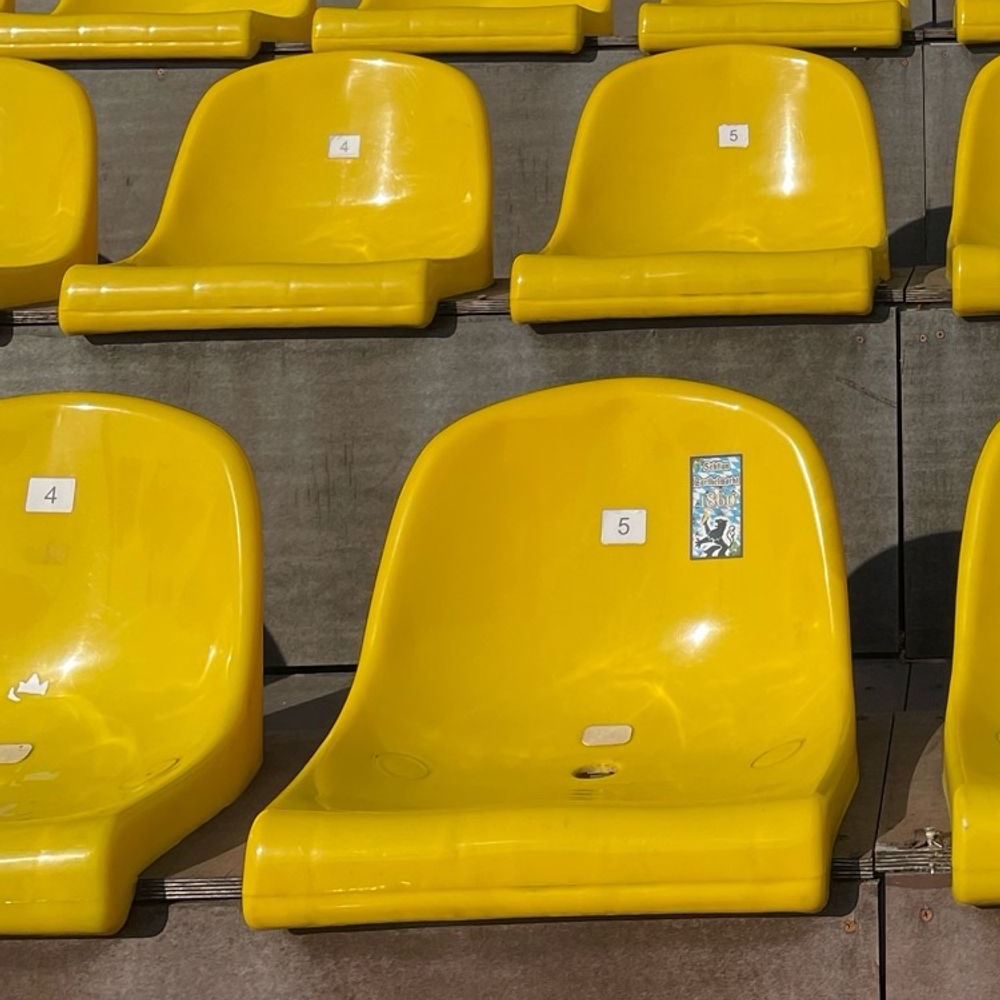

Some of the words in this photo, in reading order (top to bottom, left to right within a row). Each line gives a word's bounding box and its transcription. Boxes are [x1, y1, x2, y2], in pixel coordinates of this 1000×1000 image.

[729, 129, 738, 142] 5
[339, 140, 348, 153] 4
[43, 486, 58, 505] 4
[617, 517, 631, 536] 5
